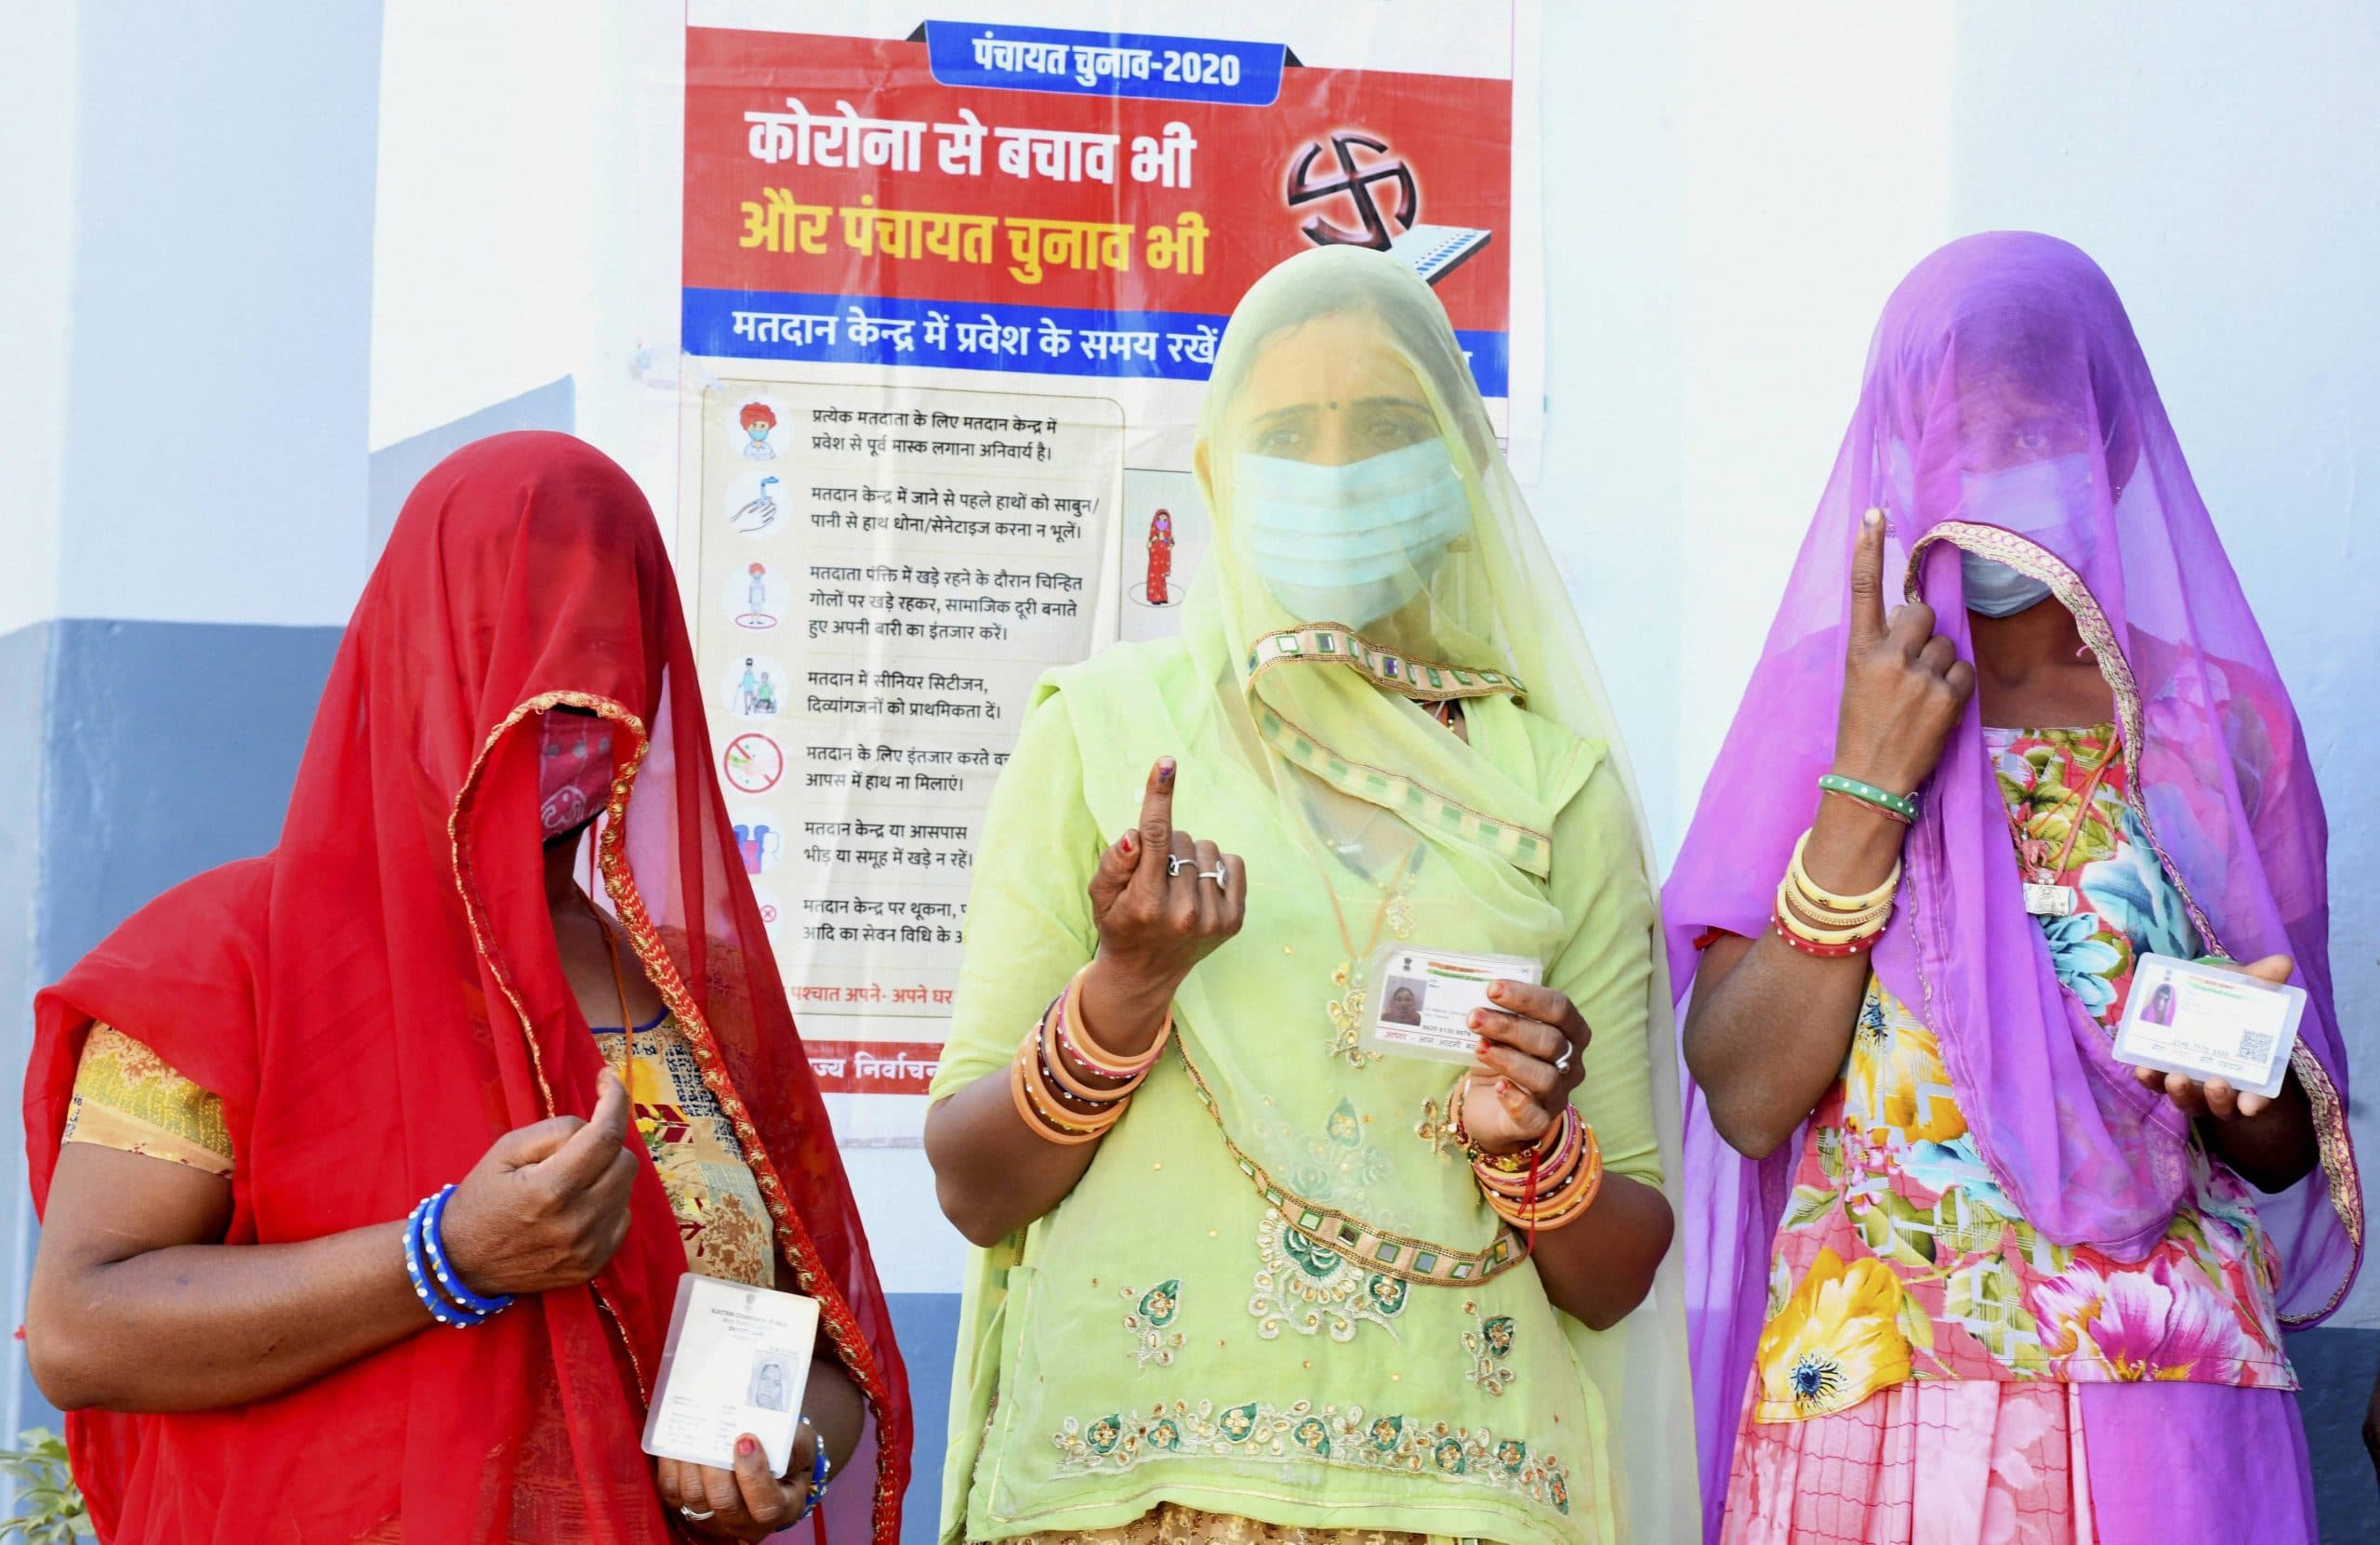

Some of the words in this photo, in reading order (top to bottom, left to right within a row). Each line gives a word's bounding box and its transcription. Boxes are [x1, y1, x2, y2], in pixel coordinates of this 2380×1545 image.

[972, 31, 1070, 74] पंचायत
[1072, 43, 1240, 88] चुनाव-2020
[744, 98, 928, 172] कोरोना
[933, 108, 988, 176] से
[994, 127, 1120, 184] बचाव
[1131, 121, 1197, 188] भी
[739, 187, 833, 255] और
[840, 193, 998, 264] पंचायत
[1004, 214, 1134, 284] चुनाव
[1146, 211, 1210, 275] भी
[732, 311, 840, 348] मतदान
[845, 306, 917, 357] केन्द्र
[922, 310, 950, 350] में
[956, 313, 1031, 355] प्रवेश
[1038, 317, 1073, 357] के
[1078, 326, 1159, 364] समय
[1166, 324, 1219, 364] रखें
[813, 406, 853, 423] प्रत्येक
[857, 412, 910, 426] मतदाता
[913, 409, 928, 427] के
[932, 412, 959, 429] लिए
[963, 416, 1009, 431] मतदान
[1012, 416, 1043, 434] केन्द्र
[812, 432, 845, 450] प्रवेश
[849, 433, 863, 451] से
[866, 435, 887, 456] पूर्व
[892, 440, 928, 453] मास्क
[932, 442, 975, 456] लगाना
[980, 441, 1033, 458] अनिवार्य
[1037, 442, 1051, 462] है।
[812, 488, 858, 502] मतदान
[862, 485, 892, 504] केन्द्र
[897, 486, 907, 504] में
[911, 488, 939, 506] जाने
[943, 489, 956, 506] से
[959, 491, 992, 509] पहले
[997, 492, 1027, 510] हाथों
[1031, 494, 1050, 510] को
[1054, 498, 1099, 517] साबुन/
[811, 510, 841, 528] पानी
[845, 511, 858, 528] से
[863, 517, 889, 532] हाथ
[995, 522, 1032, 535] करना
[1036, 524, 1047, 537] न
[1051, 521, 1080, 543] भूलें।
[811, 566, 862, 581] मतदाता
[902, 565, 912, 583] में
[916, 567, 940, 588] खड़े
[944, 568, 972, 587] रहने
[975, 569, 989, 586] के
[994, 569, 1031, 588] दौरान
[810, 588, 844, 607] गोलों
[848, 595, 866, 608] पर
[898, 597, 940, 614] रहकर,
[945, 596, 1012, 614] सामाजिक
[1014, 598, 1038, 620] दूरी
[1041, 599, 1078, 616] बनाते
[809, 620, 828, 639] हुए
[833, 618, 869, 635] अपनी
[906, 624, 925, 637] का
[929, 621, 975, 640] इंतजार
[979, 623, 1007, 640] करें।
[808, 672, 854, 687] मतदान
[875, 670, 924, 689] सीनियर
[928, 673, 987, 693] सिटीजन,
[887, 697, 906, 715] को
[909, 700, 982, 718] प्राथमिकता
[985, 701, 1000, 720] दें।
[806, 746, 853, 761] मतदान
[857, 744, 871, 760] के
[877, 745, 903, 762] लिए
[906, 747, 953, 765] इंतजार
[958, 748, 989, 765] करते
[806, 773, 845, 786] आपस
[852, 771, 862, 787] में
[866, 775, 892, 790] हाथ
[895, 776, 910, 789] ना
[915, 773, 962, 791] मिलाएं।
[804, 822, 852, 836] मतदान
[855, 819, 885, 838] केन्द्र
[889, 825, 906, 838] या
[910, 825, 967, 839] आसपास
[836, 850, 852, 863] या
[855, 851, 889, 868] समूह
[892, 847, 904, 865] में
[907, 848, 932, 868] खड़े
[935, 853, 946, 865] न
[950, 849, 972, 868] रहें।
[803, 900, 849, 914] मतदान
[853, 896, 884, 915] केन्द्र
[888, 902, 906, 915] पर
[910, 903, 956, 920] थूकना,
[804, 923, 835, 941] आदि
[840, 928, 859, 941] का
[863, 924, 896, 942] सेवन
[901, 925, 932, 943] विधि
[937, 926, 951, 943] के
[791, 986, 840, 1001] पश्चात
[892, 984, 928, 1004] अपने
[932, 990, 953, 1004] घर
[808, 1058, 847, 1077] ज्य
